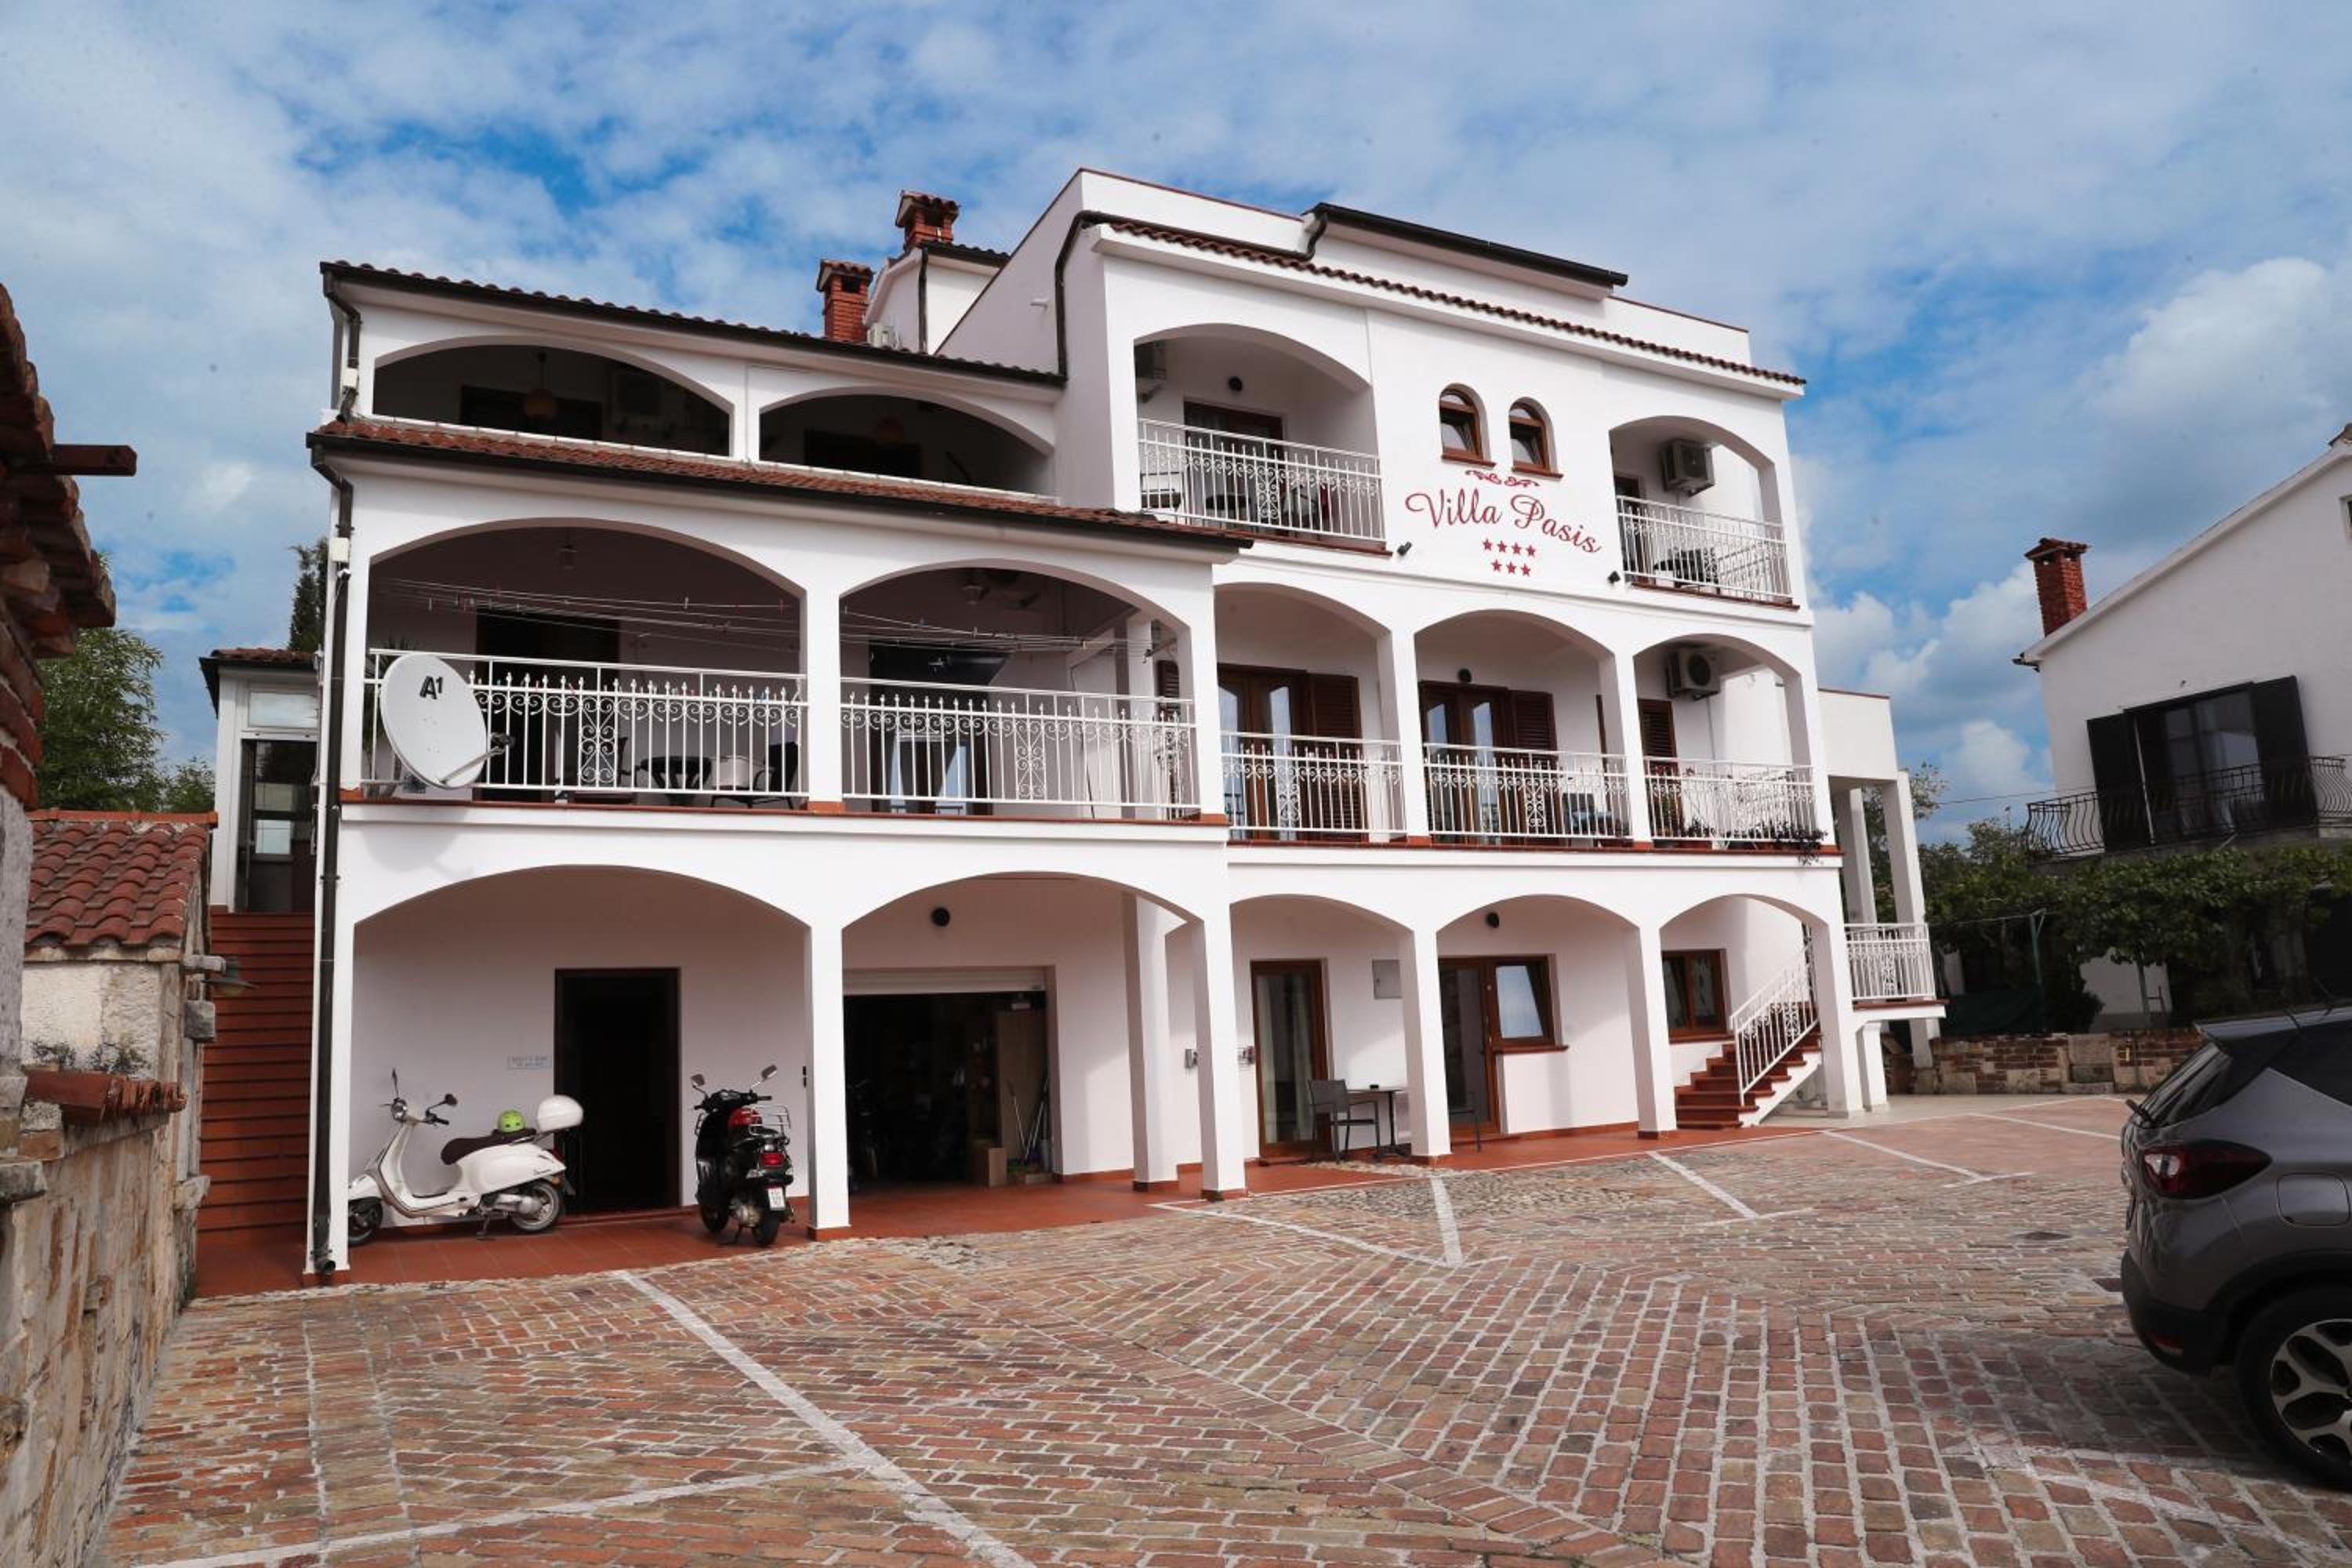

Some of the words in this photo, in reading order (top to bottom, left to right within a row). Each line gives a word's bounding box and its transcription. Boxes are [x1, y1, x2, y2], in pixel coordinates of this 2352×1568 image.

[1405, 488, 1502, 528] Villa
[1510, 494, 1601, 553] Pasis
[419, 676, 443, 699] A1
